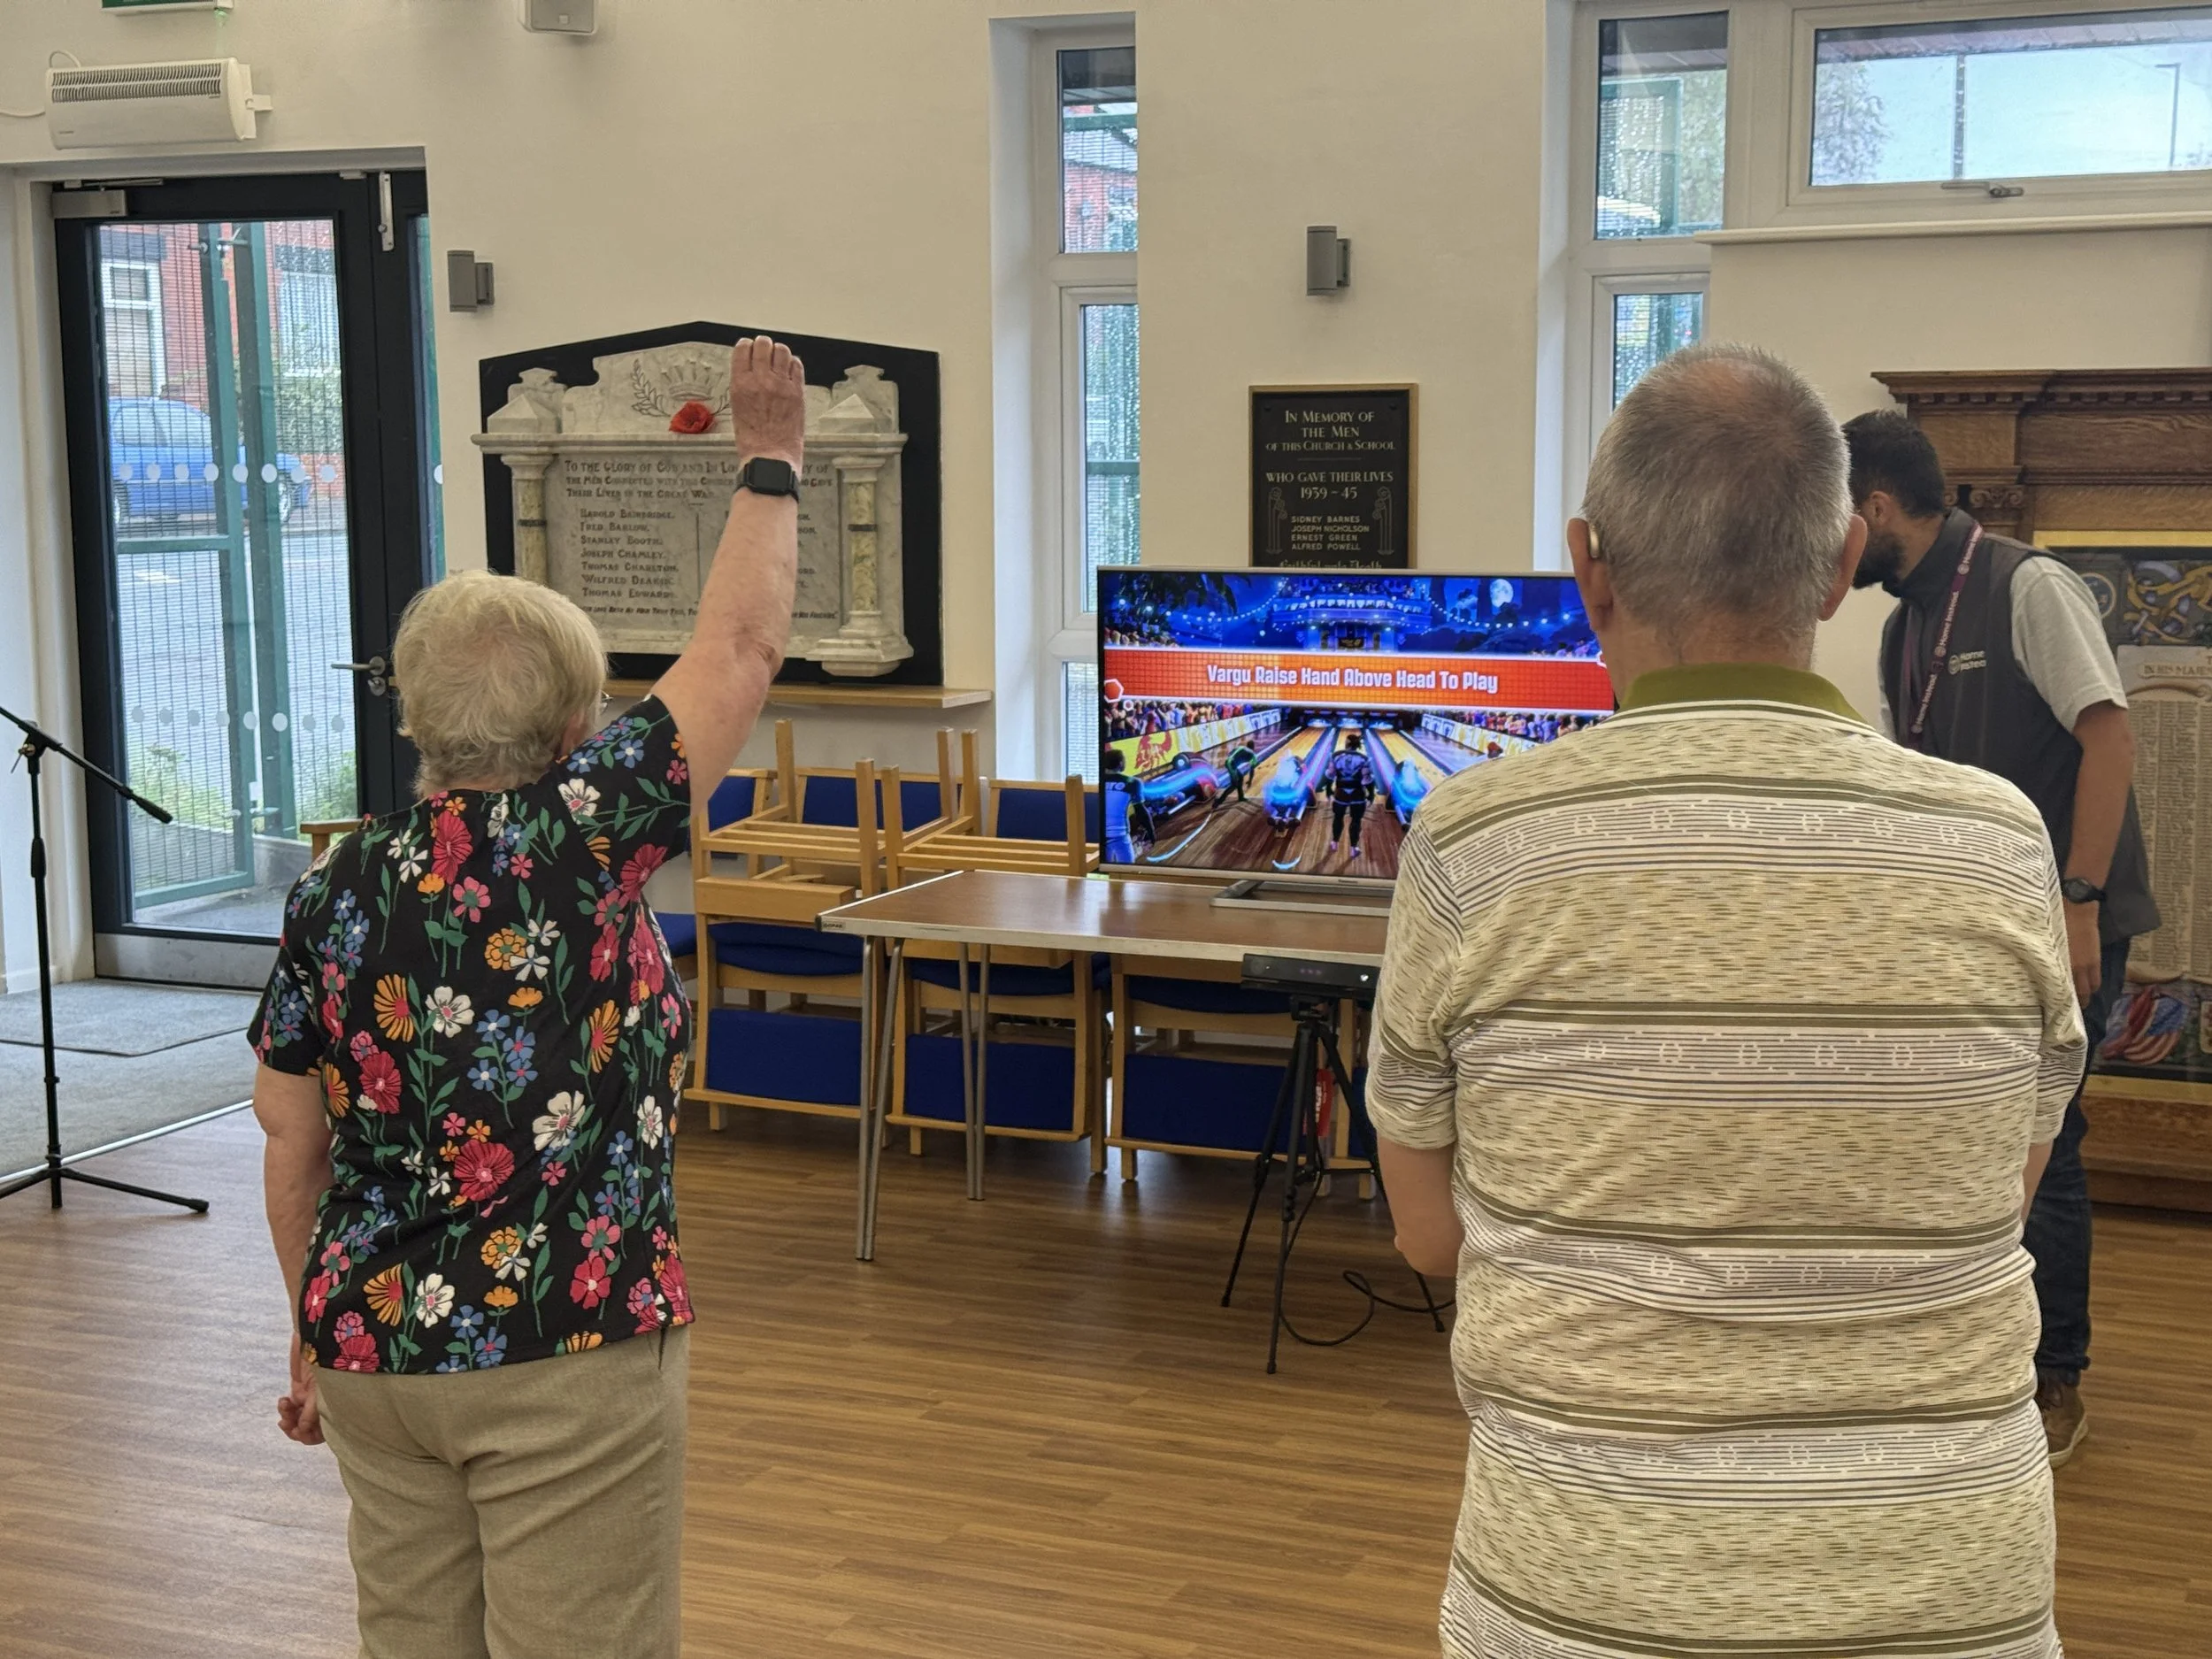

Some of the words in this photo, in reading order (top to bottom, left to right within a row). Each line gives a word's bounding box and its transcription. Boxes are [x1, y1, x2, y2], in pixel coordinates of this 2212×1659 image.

[1302, 411, 1354, 423] MEMORY
[1358, 411, 1375, 422] OF
[1302, 427, 1325, 438] THE
[1332, 426, 1360, 437] MEN
[1303, 442, 1345, 450] CHURCH
[1355, 441, 1395, 450] SCHOOL
[1266, 472, 1294, 482] WHO
[1297, 472, 1326, 482] GAVE
[1330, 472, 1363, 482] THEIR
[1363, 472, 1394, 482] LIVES
[1301, 487, 1327, 500] 1939
[1340, 487, 1357, 499] 45
[1207, 664, 1251, 685] Vargu
[1255, 666, 1297, 685] Raise
[1301, 667, 1340, 686] Hand
[1344, 669, 1392, 687] Above
[1396, 670, 1436, 689] Head
[1440, 671, 1458, 689] To
[1463, 671, 1499, 694] Play
